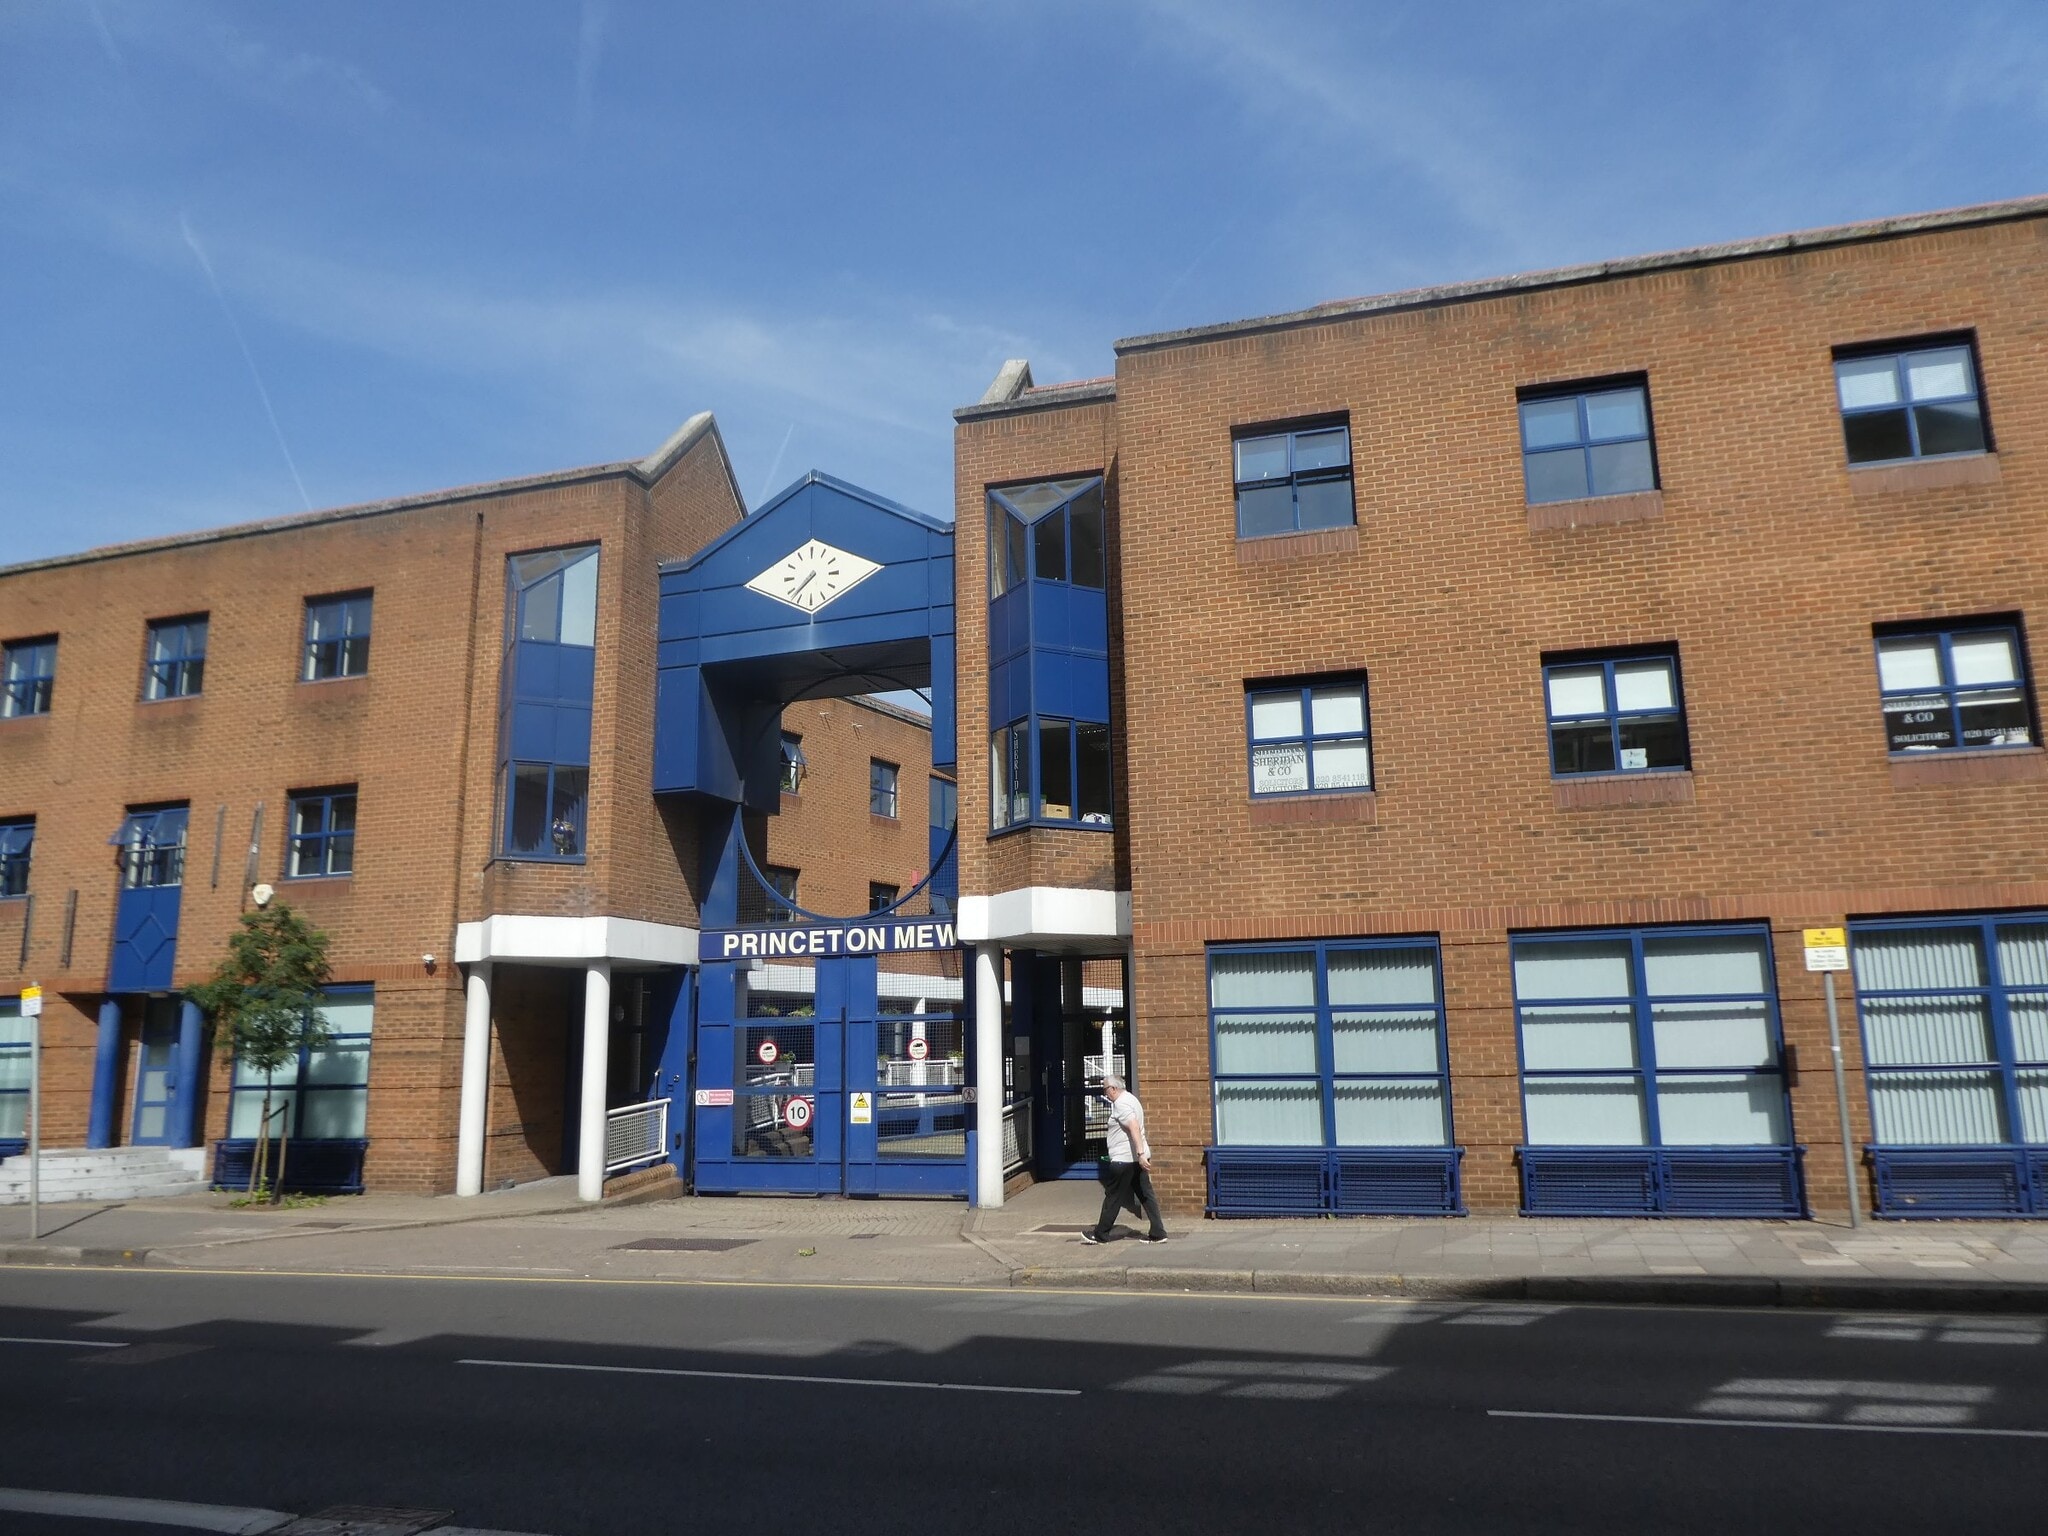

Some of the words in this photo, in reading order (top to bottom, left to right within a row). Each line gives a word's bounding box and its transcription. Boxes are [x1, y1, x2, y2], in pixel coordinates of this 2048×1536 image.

[1904, 713, 1914, 724] &
[1916, 712, 1934, 723] CO
[1893, 732, 1950, 743] SOLICITORS
[1253, 755, 1305, 767] SHERIDAN
[1268, 767, 1275, 777] &
[1277, 766, 1292, 776] CO
[723, 927, 885, 957] PRINCETON
[894, 922, 958, 950] MEW
[790, 1106, 807, 1120] 10
